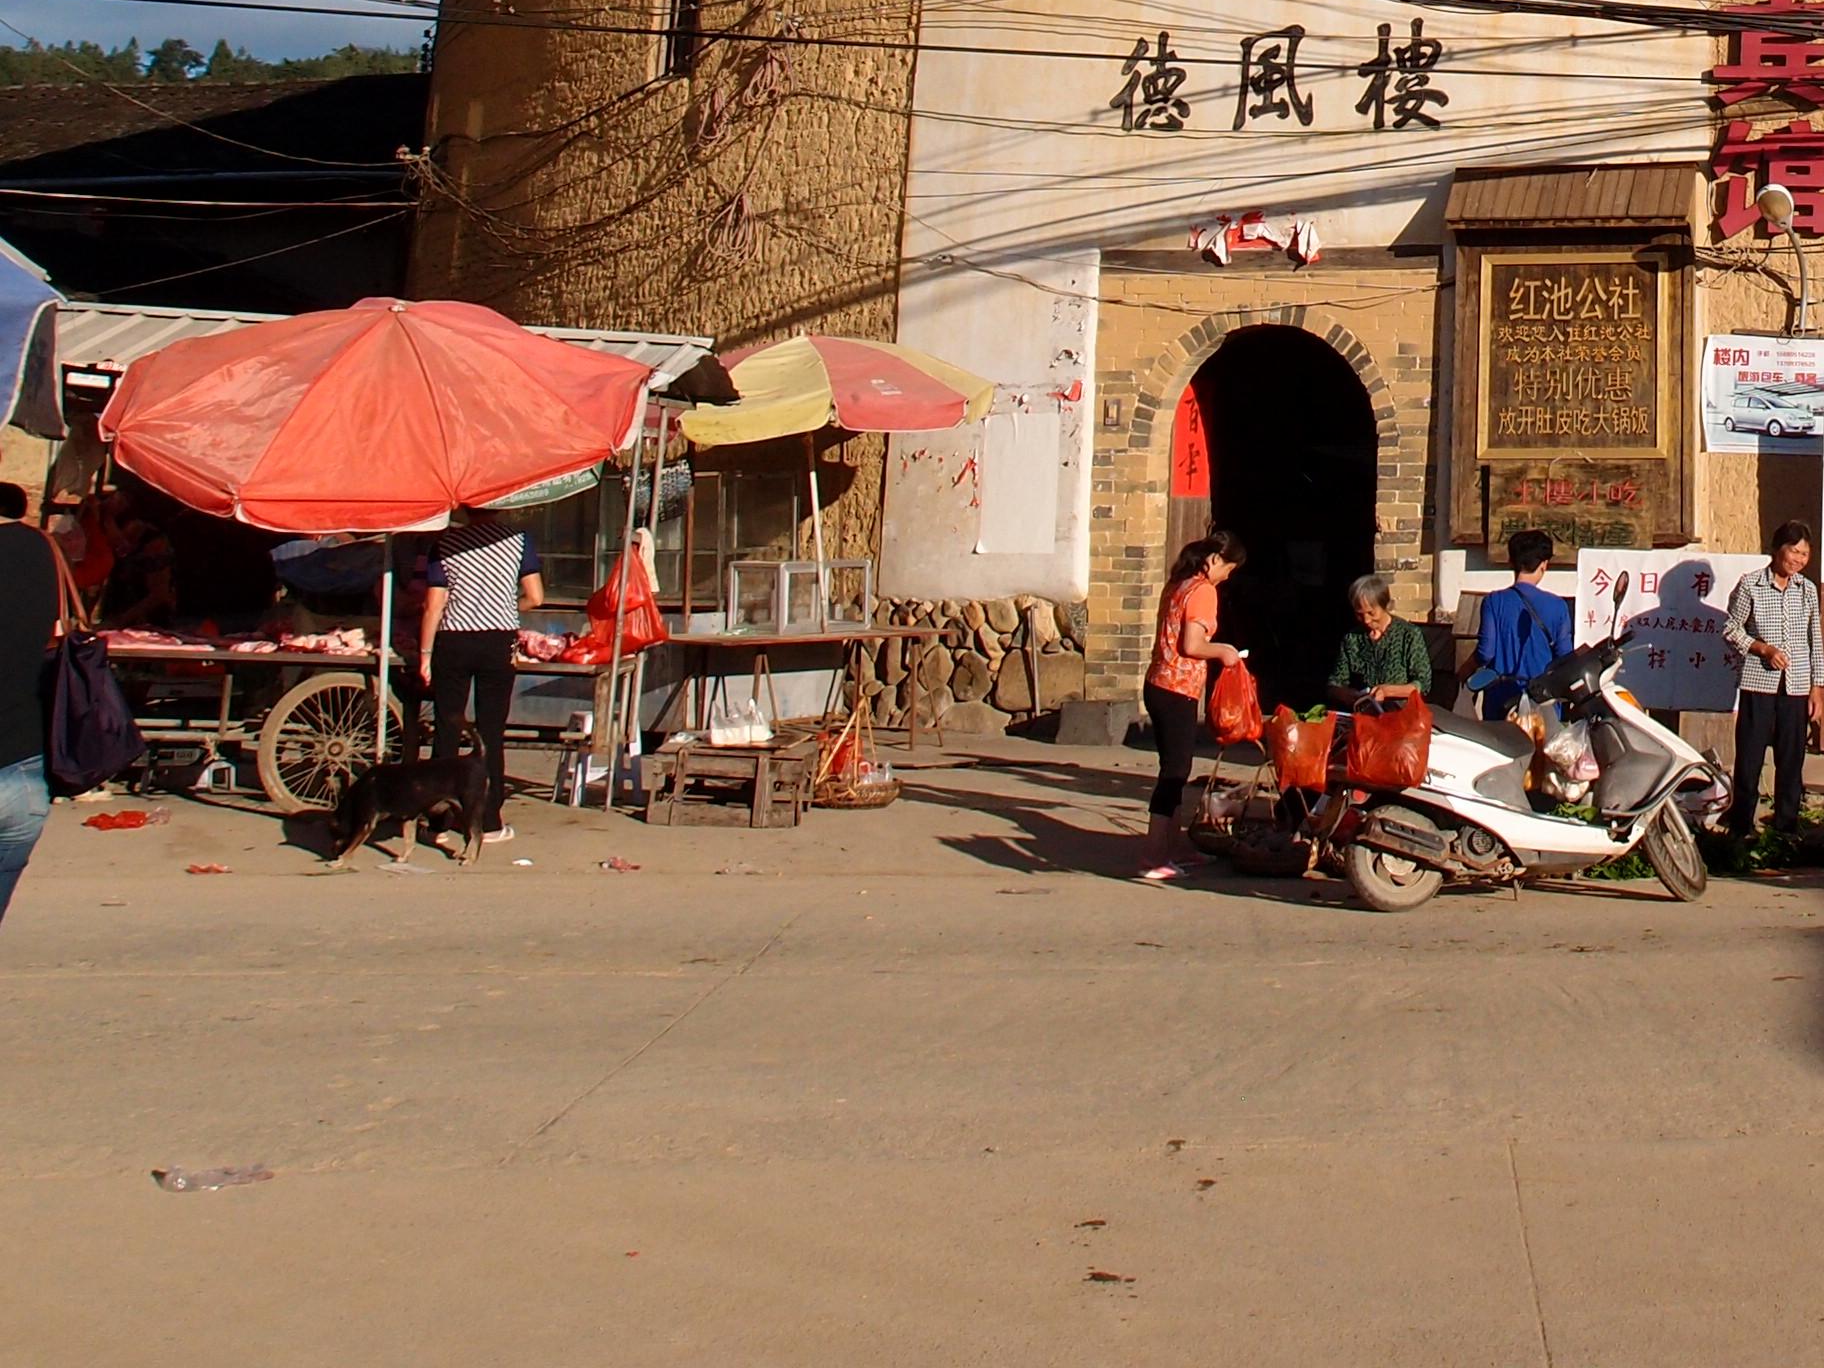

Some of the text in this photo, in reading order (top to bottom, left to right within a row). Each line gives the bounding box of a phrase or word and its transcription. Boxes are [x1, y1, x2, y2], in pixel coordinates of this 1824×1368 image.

[1509, 275, 1642, 321] 红池公社
[1496, 323, 1653, 343] 欢迎您入住红池公社
[1506, 345, 1642, 364] 成为本社荣誉会员
[1713, 347, 1750, 366] 楼内
[1513, 366, 1633, 402] 特别优惠
[1498, 405, 1650, 436] 放开肚皮吃大锅饭
